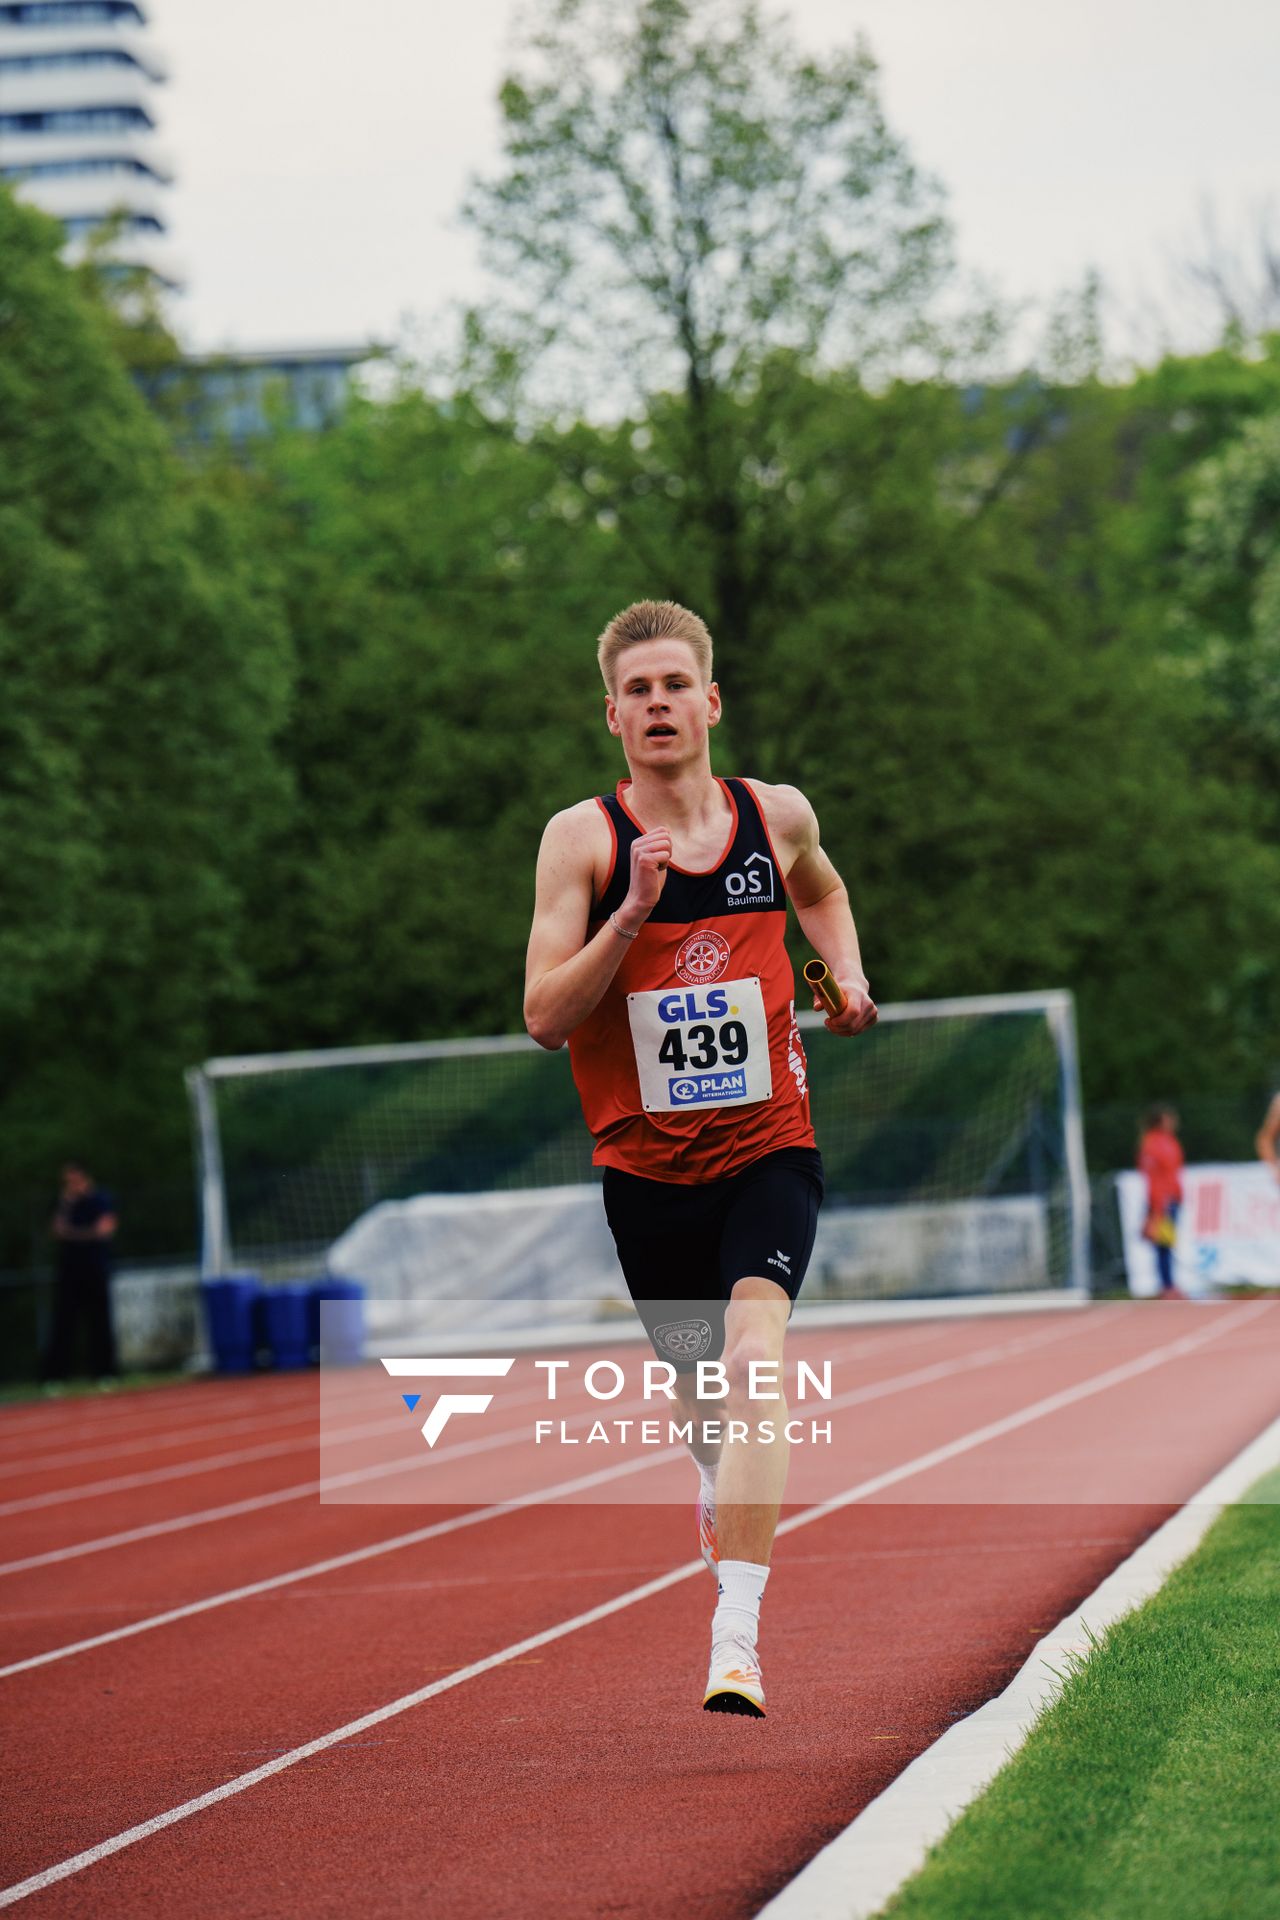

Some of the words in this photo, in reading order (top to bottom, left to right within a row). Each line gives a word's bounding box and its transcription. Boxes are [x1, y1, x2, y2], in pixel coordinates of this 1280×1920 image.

[725, 870, 762, 896] OS
[719, 951, 728, 961] G
[658, 1020, 749, 1072] 439
[700, 1075, 743, 1092] PLAN
[702, 1089, 744, 1098] INTERNATIONAL
